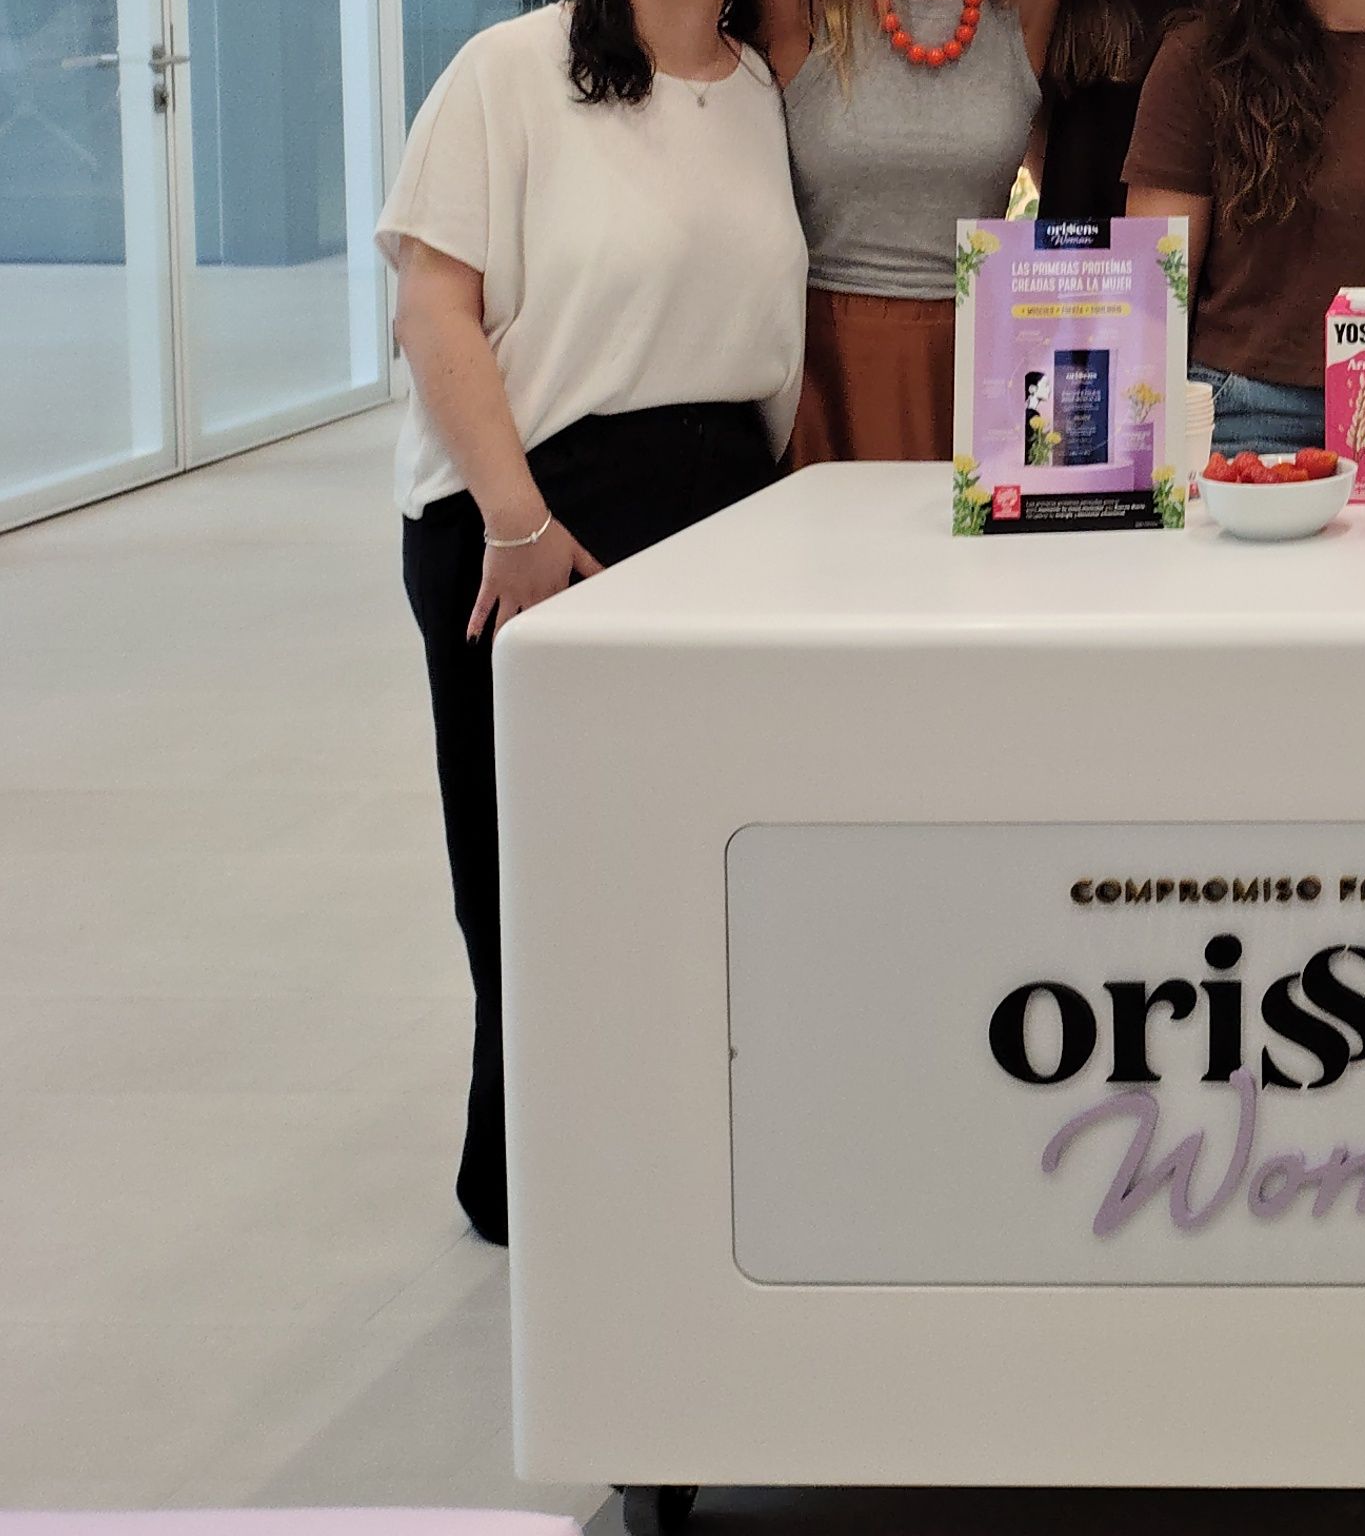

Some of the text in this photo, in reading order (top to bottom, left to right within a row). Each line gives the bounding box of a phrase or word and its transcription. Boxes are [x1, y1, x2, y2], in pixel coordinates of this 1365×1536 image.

[1011, 261, 1030, 276] LAS
[1032, 261, 1080, 276] PRIMERAS
[1058, 276, 1084, 292] PARA
[1086, 277, 1099, 291] LA
[1070, 876, 1322, 906] COMPROMISO
